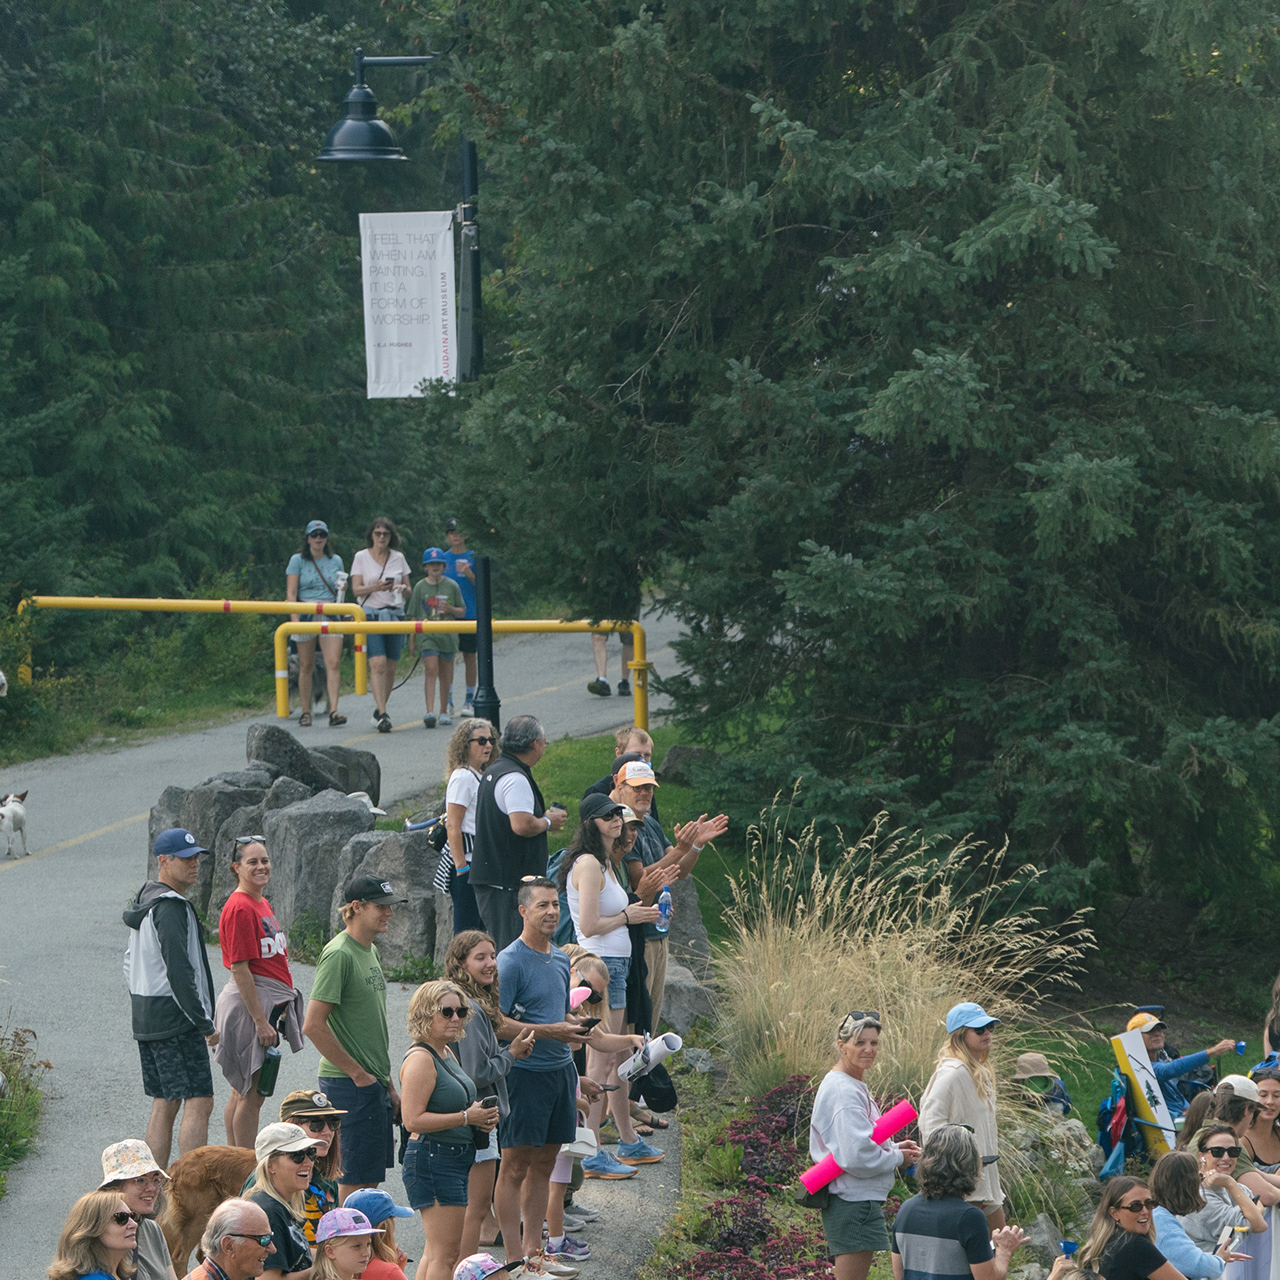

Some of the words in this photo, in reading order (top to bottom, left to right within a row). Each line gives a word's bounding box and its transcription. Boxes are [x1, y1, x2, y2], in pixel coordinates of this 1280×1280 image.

[374, 233, 403, 245] FEEL
[406, 233, 437, 245] THAT
[370, 250, 407, 261] WHEN
[417, 250, 437, 261] AM
[369, 265, 427, 277] PAINTING,
[370, 281, 380, 293] IT
[384, 281, 394, 293] IS
[398, 281, 407, 292] A
[440, 271, 448, 316] MUSEUM
[370, 298, 407, 310] FORM
[410, 297, 427, 309] OF
[372, 313, 431, 326] WORSHIP.
[441, 319, 449, 336] ART
[442, 338, 450, 376] AUDAIN
